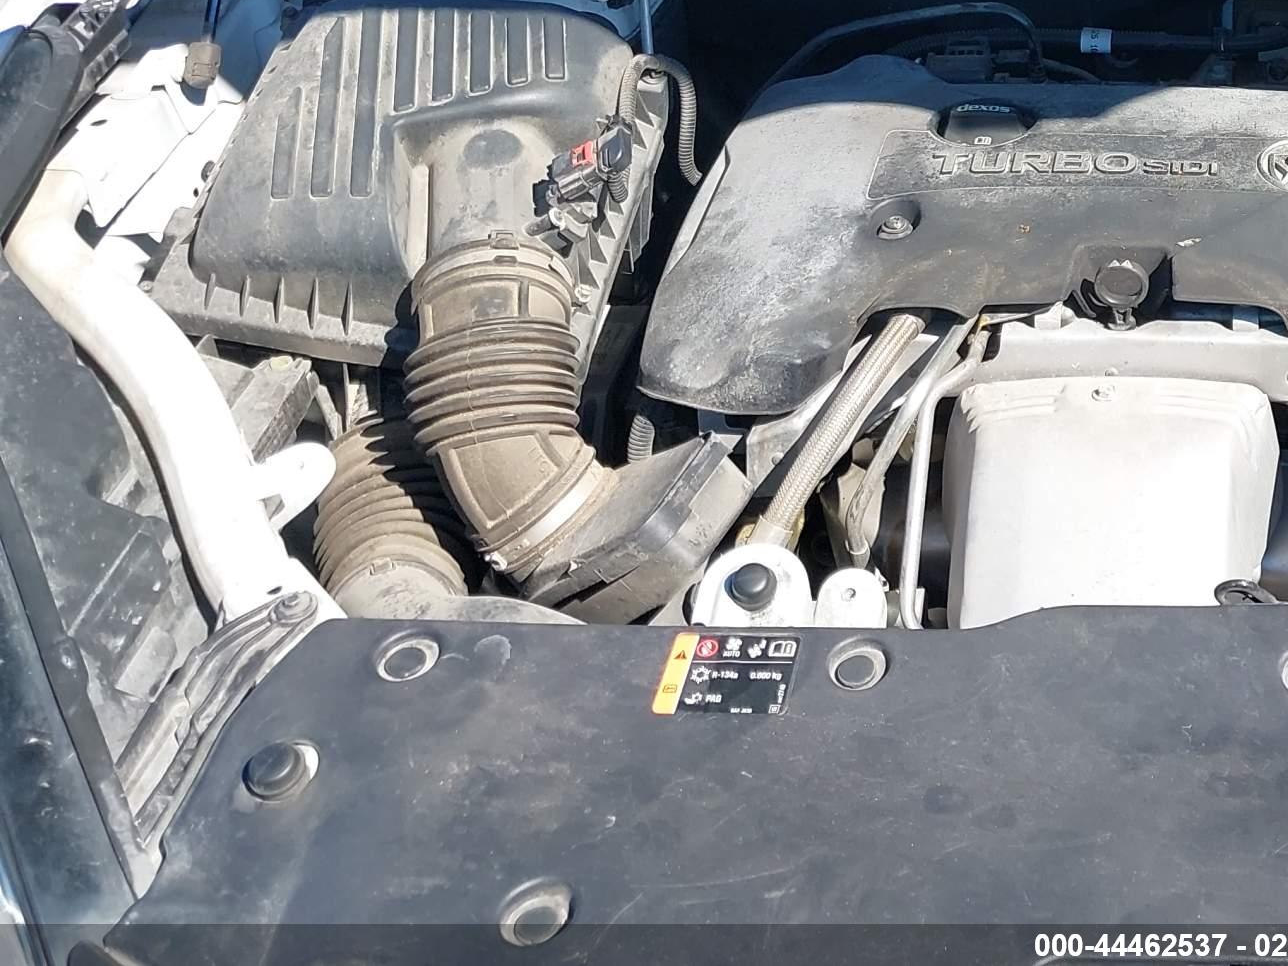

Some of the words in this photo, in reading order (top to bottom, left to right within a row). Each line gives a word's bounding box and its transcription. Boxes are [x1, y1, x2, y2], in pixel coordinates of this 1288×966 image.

[956, 103, 1011, 113] dexos
[932, 150, 1138, 176] TURBO
[722, 650, 741, 658] AUTO
